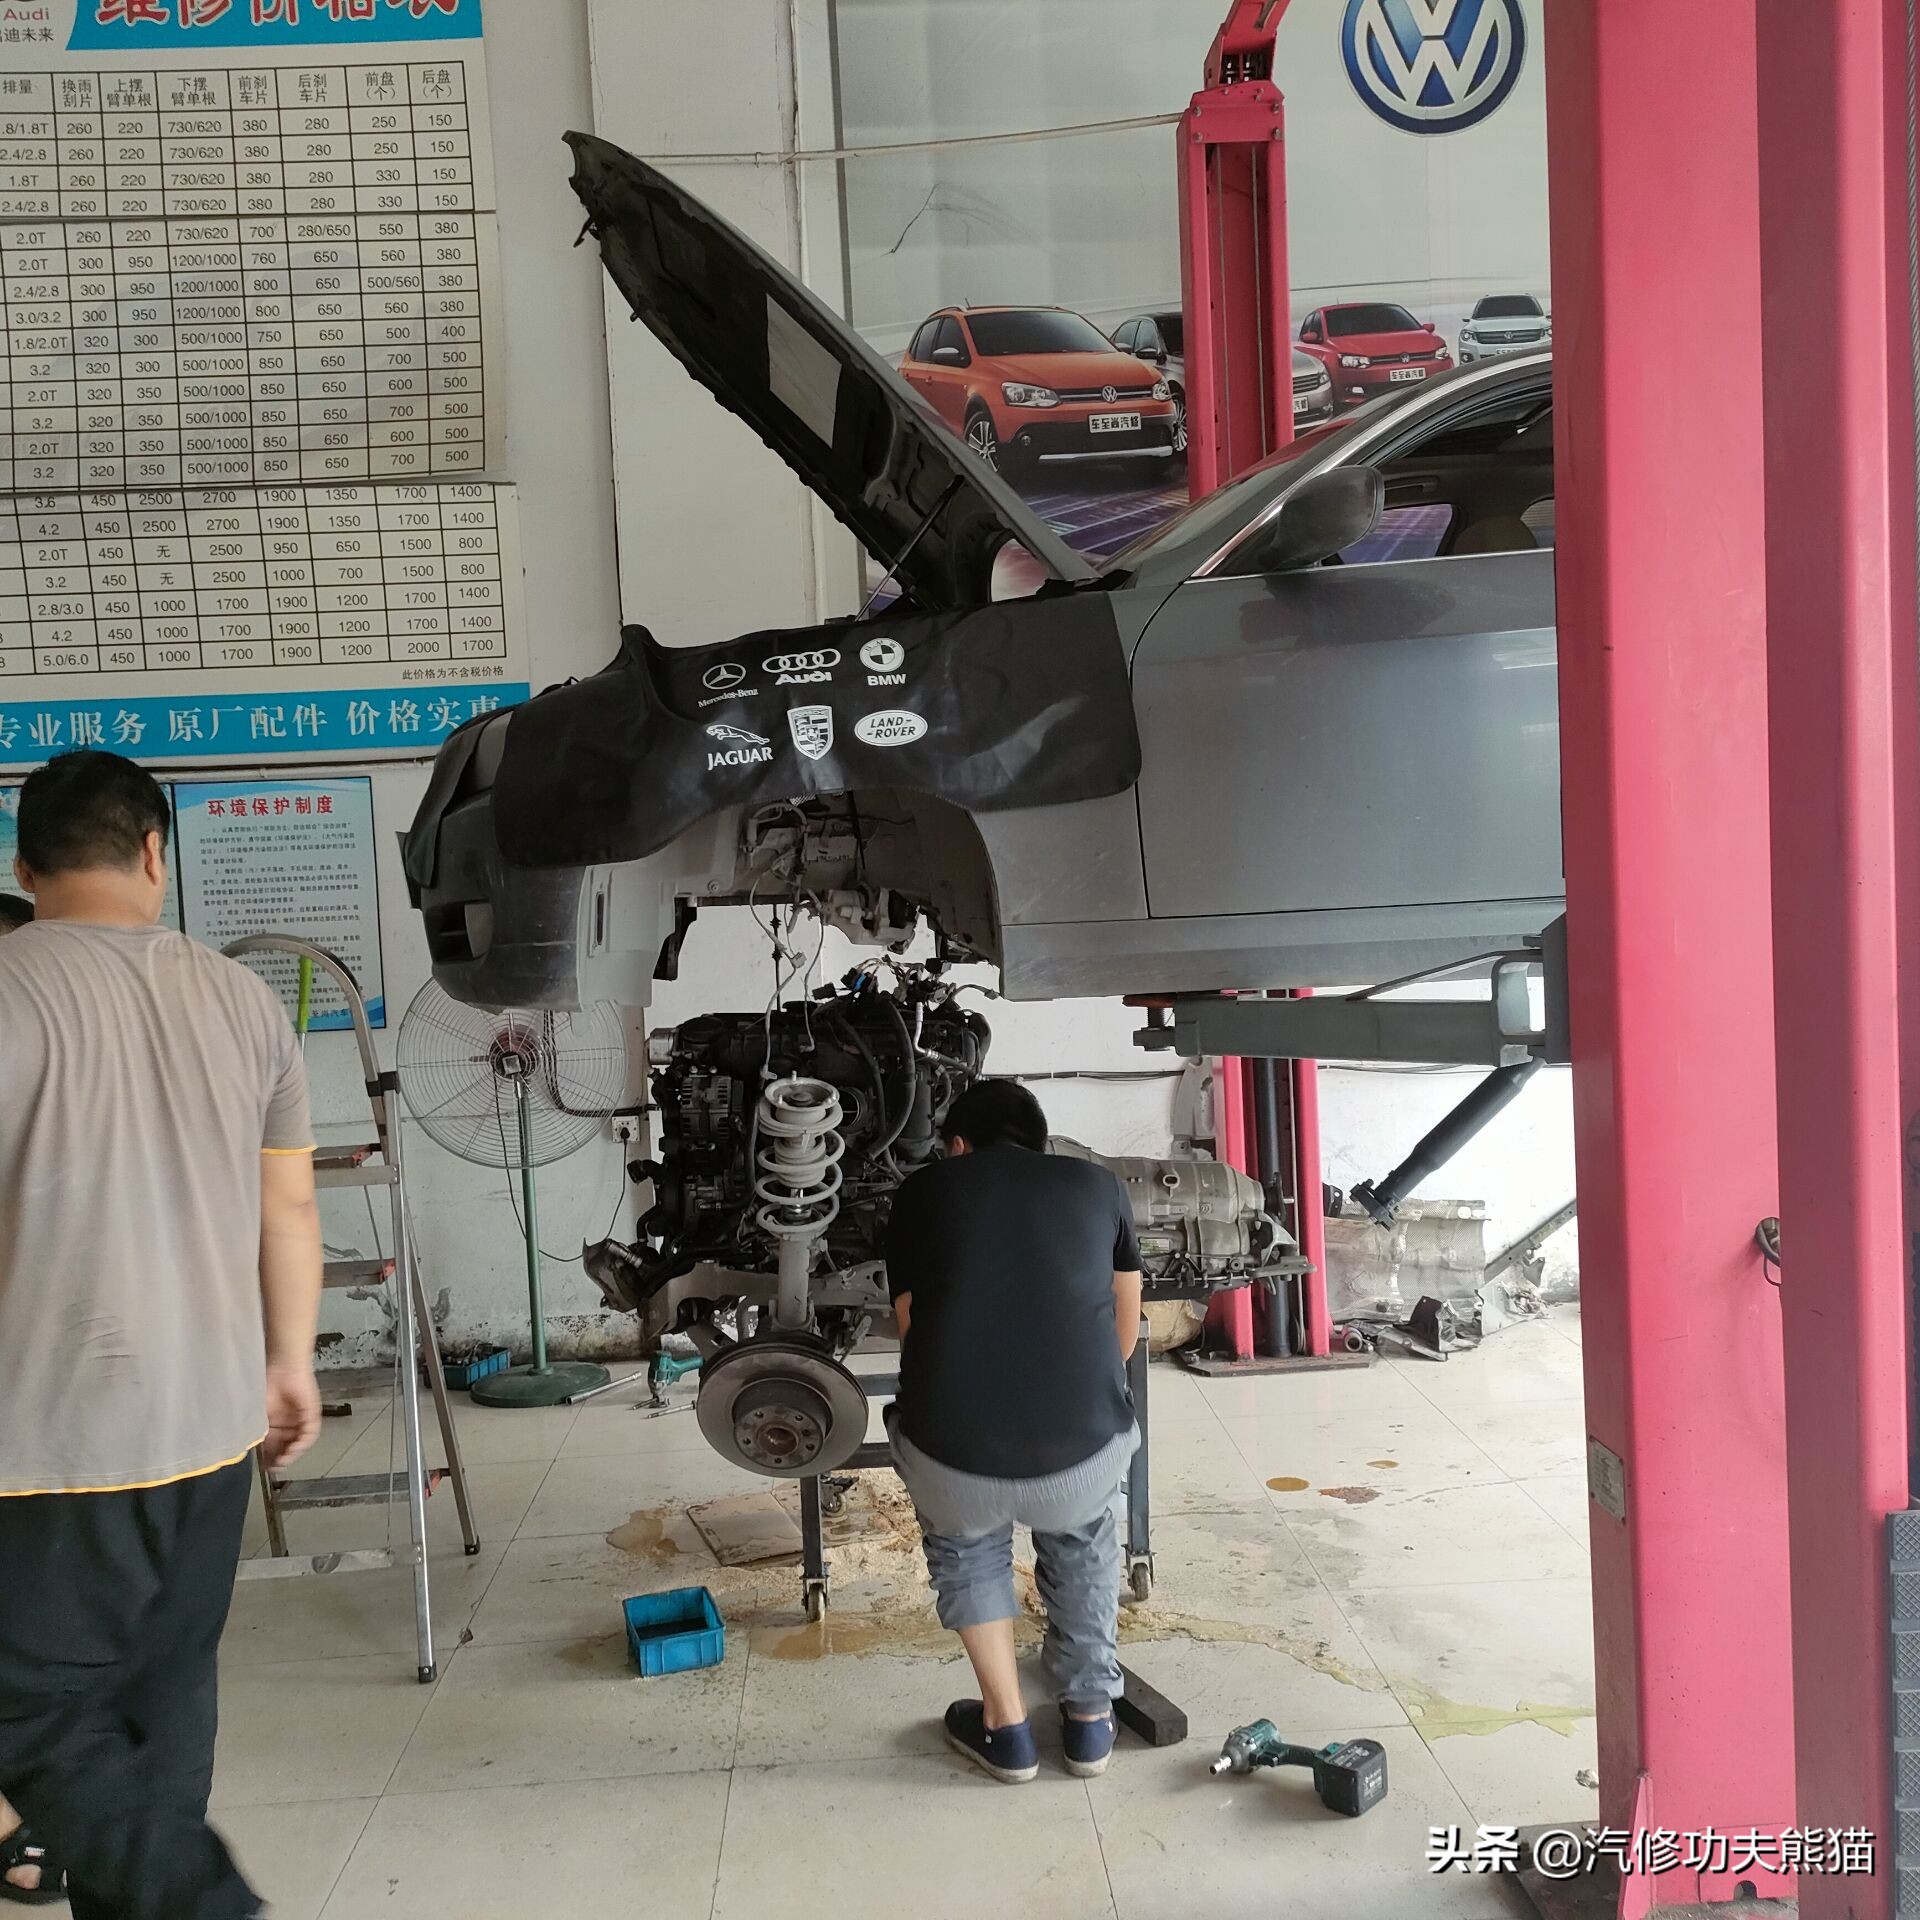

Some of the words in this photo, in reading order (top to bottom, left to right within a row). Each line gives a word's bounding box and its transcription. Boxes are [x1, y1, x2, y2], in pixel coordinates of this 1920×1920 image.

[3, 8, 50, 21] Audi
[0, 27, 54, 43] 迪未来
[3, 79, 33, 95] 排量
[62, 79, 92, 94] 换雨
[114, 78, 143, 94] 上摆
[177, 77, 207, 92] 下摆
[238, 75, 267, 91] 前刹
[298, 73, 328, 89] 后刹
[365, 71, 395, 87] 前盘
[422, 69, 451, 85] 后盘
[239, 89, 267, 105] 车片
[299, 87, 328, 103] 车片
[243, 119, 268, 132] 380
[305, 117, 330, 130] 280
[371, 115, 397, 128] 250
[428, 114, 452, 126] 150
[244, 145, 269, 158] 380
[306, 144, 332, 156] 280
[374, 142, 399, 155] 250
[431, 140, 454, 153] 150
[246, 172, 271, 184] 380
[309, 171, 334, 183] 280
[376, 169, 401, 181] 330
[433, 168, 456, 180] 150
[247, 198, 273, 210] 380
[310, 197, 335, 209] 280
[378, 196, 402, 208] 330
[435, 194, 458, 206] 150
[175, 227, 229, 240] 730/620
[249, 226, 274, 238] 700
[297, 224, 351, 237] 280/650
[379, 223, 404, 236] 550
[434, 222, 459, 234] 380
[78, 257, 103, 270] 300
[128, 256, 153, 268] 950
[251, 252, 276, 265] 760
[313, 251, 339, 263] 650
[381, 249, 406, 262] 560
[436, 248, 461, 261] 380
[80, 284, 105, 296] 300
[130, 282, 155, 295] 950
[253, 279, 279, 291] 800
[315, 277, 341, 290] 650
[367, 275, 420, 289] 500/560
[438, 274, 463, 287] 380
[132, 308, 157, 321] 950
[176, 306, 241, 319] 1200/1000
[255, 305, 280, 317] 800
[317, 303, 342, 316] 650
[384, 301, 409, 314] 560
[440, 300, 464, 313] 380
[84, 335, 109, 348] 320
[181, 331, 243, 345] 500/1000
[257, 330, 282, 343] 750
[319, 329, 344, 341] 650
[386, 327, 410, 339] 500
[441, 325, 466, 337] 400
[135, 360, 160, 373] 300
[183, 358, 244, 371] 500/1000
[259, 357, 283, 369] 850
[320, 355, 345, 367] 650
[387, 353, 412, 365] 700
[442, 351, 467, 363] 500
[87, 388, 112, 401] 320
[136, 387, 162, 399] 350
[183, 384, 245, 398] 500/1000
[260, 383, 285, 395] 850
[322, 381, 347, 393] 650
[138, 414, 163, 426] 350
[185, 411, 247, 424] 500/1000
[261, 410, 286, 423] 850
[323, 408, 348, 420] 650
[139, 440, 164, 452] 350
[263, 436, 287, 448] 850
[390, 430, 414, 442] 600
[90, 465, 115, 477] 320
[140, 464, 165, 476] 350
[263, 460, 288, 472] 850
[325, 457, 349, 469] 650
[202, 491, 236, 504] 2700
[264, 489, 296, 502] 1900
[326, 488, 358, 500] 1350
[395, 486, 427, 499] 1700
[451, 485, 482, 497] 1400
[95, 521, 120, 534] 450
[142, 520, 176, 532] 2500
[206, 518, 240, 531] 2700
[267, 517, 300, 529] 1900
[328, 515, 361, 528] 1350
[398, 513, 430, 525] 1700
[453, 512, 484, 524] 1400
[38, 548, 68, 561] 2.0T
[98, 547, 124, 559] 450
[156, 545, 171, 558] 无
[209, 543, 243, 556] 2500
[273, 542, 298, 554] 950
[336, 540, 361, 553] 650
[400, 538, 432, 551] 1500
[458, 537, 483, 549] 800
[45, 576, 67, 589] 3.2
[102, 574, 127, 586] 450
[159, 572, 174, 585] 无
[212, 570, 246, 583] 2500
[273, 569, 305, 581] 1000
[338, 567, 363, 579] 700
[402, 565, 434, 577] 1500
[461, 563, 485, 576] 800
[104, 601, 130, 613] 450
[153, 599, 186, 612] 1000
[216, 597, 249, 610] 1700
[276, 596, 308, 608] 1900
[336, 594, 368, 606] 1200
[404, 591, 436, 604] 1700
[458, 586, 490, 599] 1400
[107, 628, 133, 640] 450
[156, 626, 188, 638] 1000
[278, 622, 310, 634] 1900
[339, 620, 370, 632] 1200
[407, 618, 438, 630] 1700
[461, 616, 492, 628] 1400
[43, 653, 89, 667] 5.0/6.0
[110, 652, 135, 664] 450
[158, 650, 191, 662] 1000
[280, 646, 312, 658] 1900
[341, 644, 372, 656] 1200
[407, 641, 440, 654] 2000
[463, 639, 494, 651] 1700
[402, 666, 504, 680] 此价格为不含税价格
[867, 673, 907, 686] BMW
[697, 688, 759, 708] Mercedes-Benz
[0, 709, 147, 749] 专业服务
[168, 703, 328, 743] 原厂配件
[707, 747, 774, 771] JAGUAR
[207, 795, 334, 817] 环境保护制度
